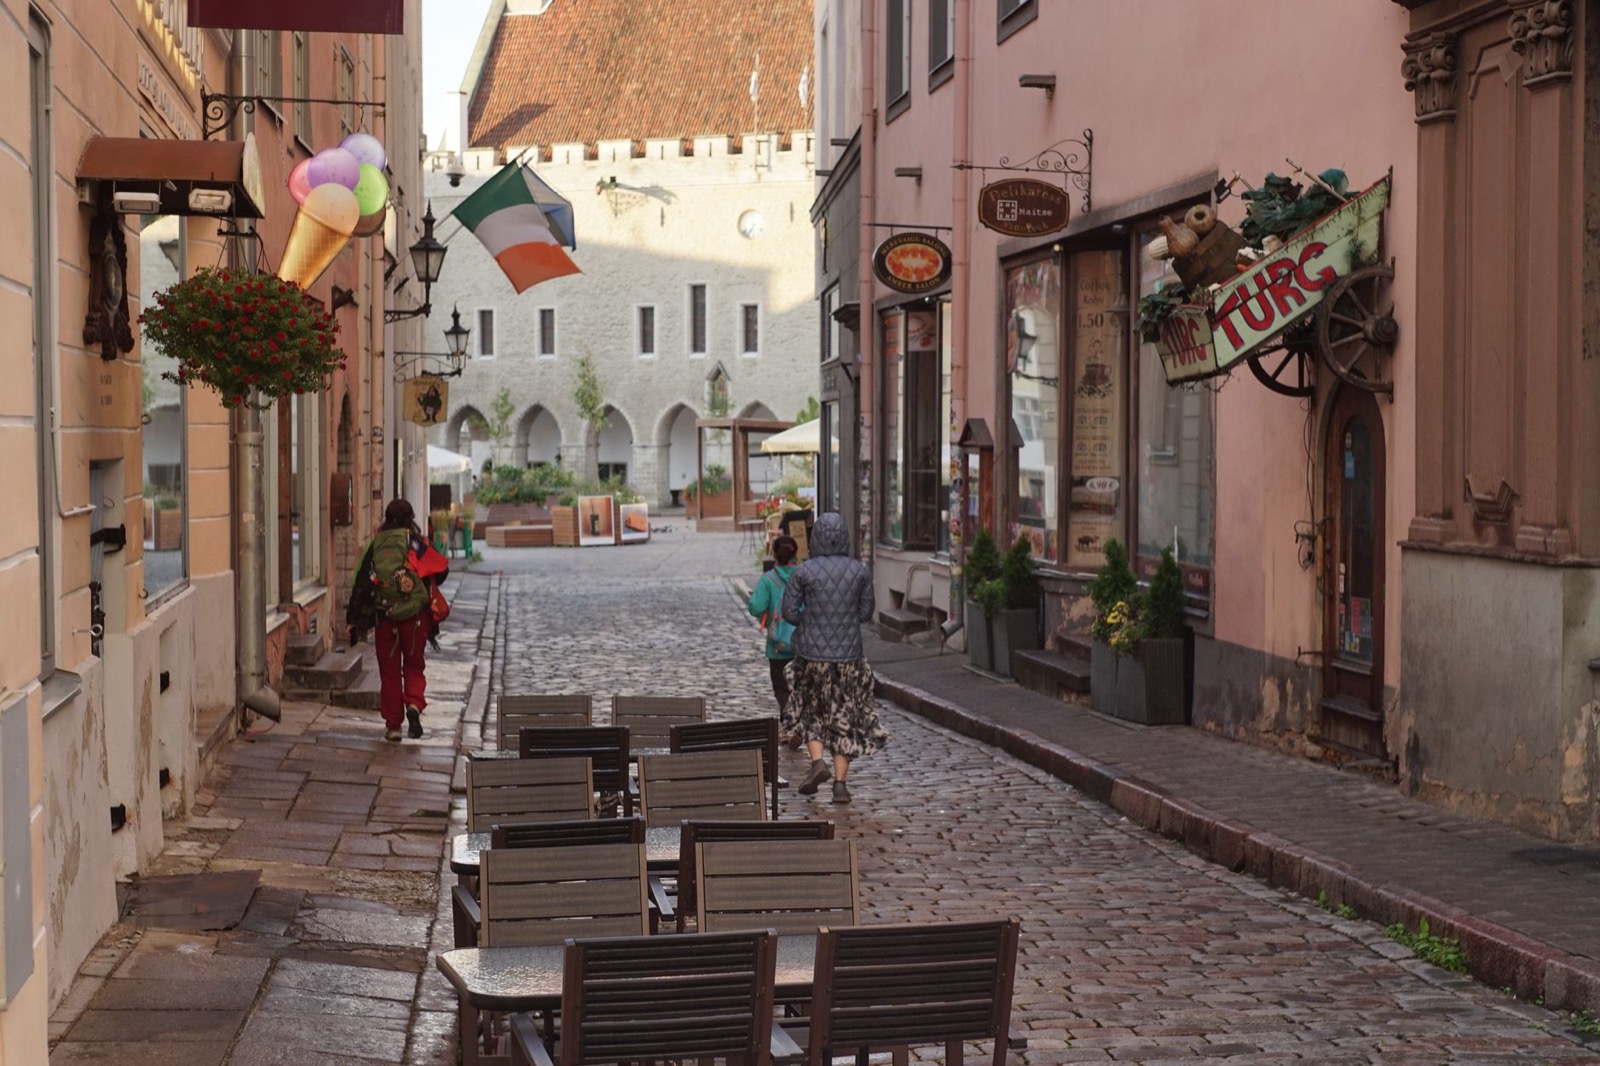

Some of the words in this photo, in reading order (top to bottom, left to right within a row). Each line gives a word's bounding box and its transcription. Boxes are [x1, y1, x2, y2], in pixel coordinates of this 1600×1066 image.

[922, 237, 948, 258] SALONG
[886, 276, 913, 289] AMBER
[915, 276, 941, 289] SALON
[1211, 241, 1337, 352] TURG
[1078, 313, 1104, 328] 1.50
